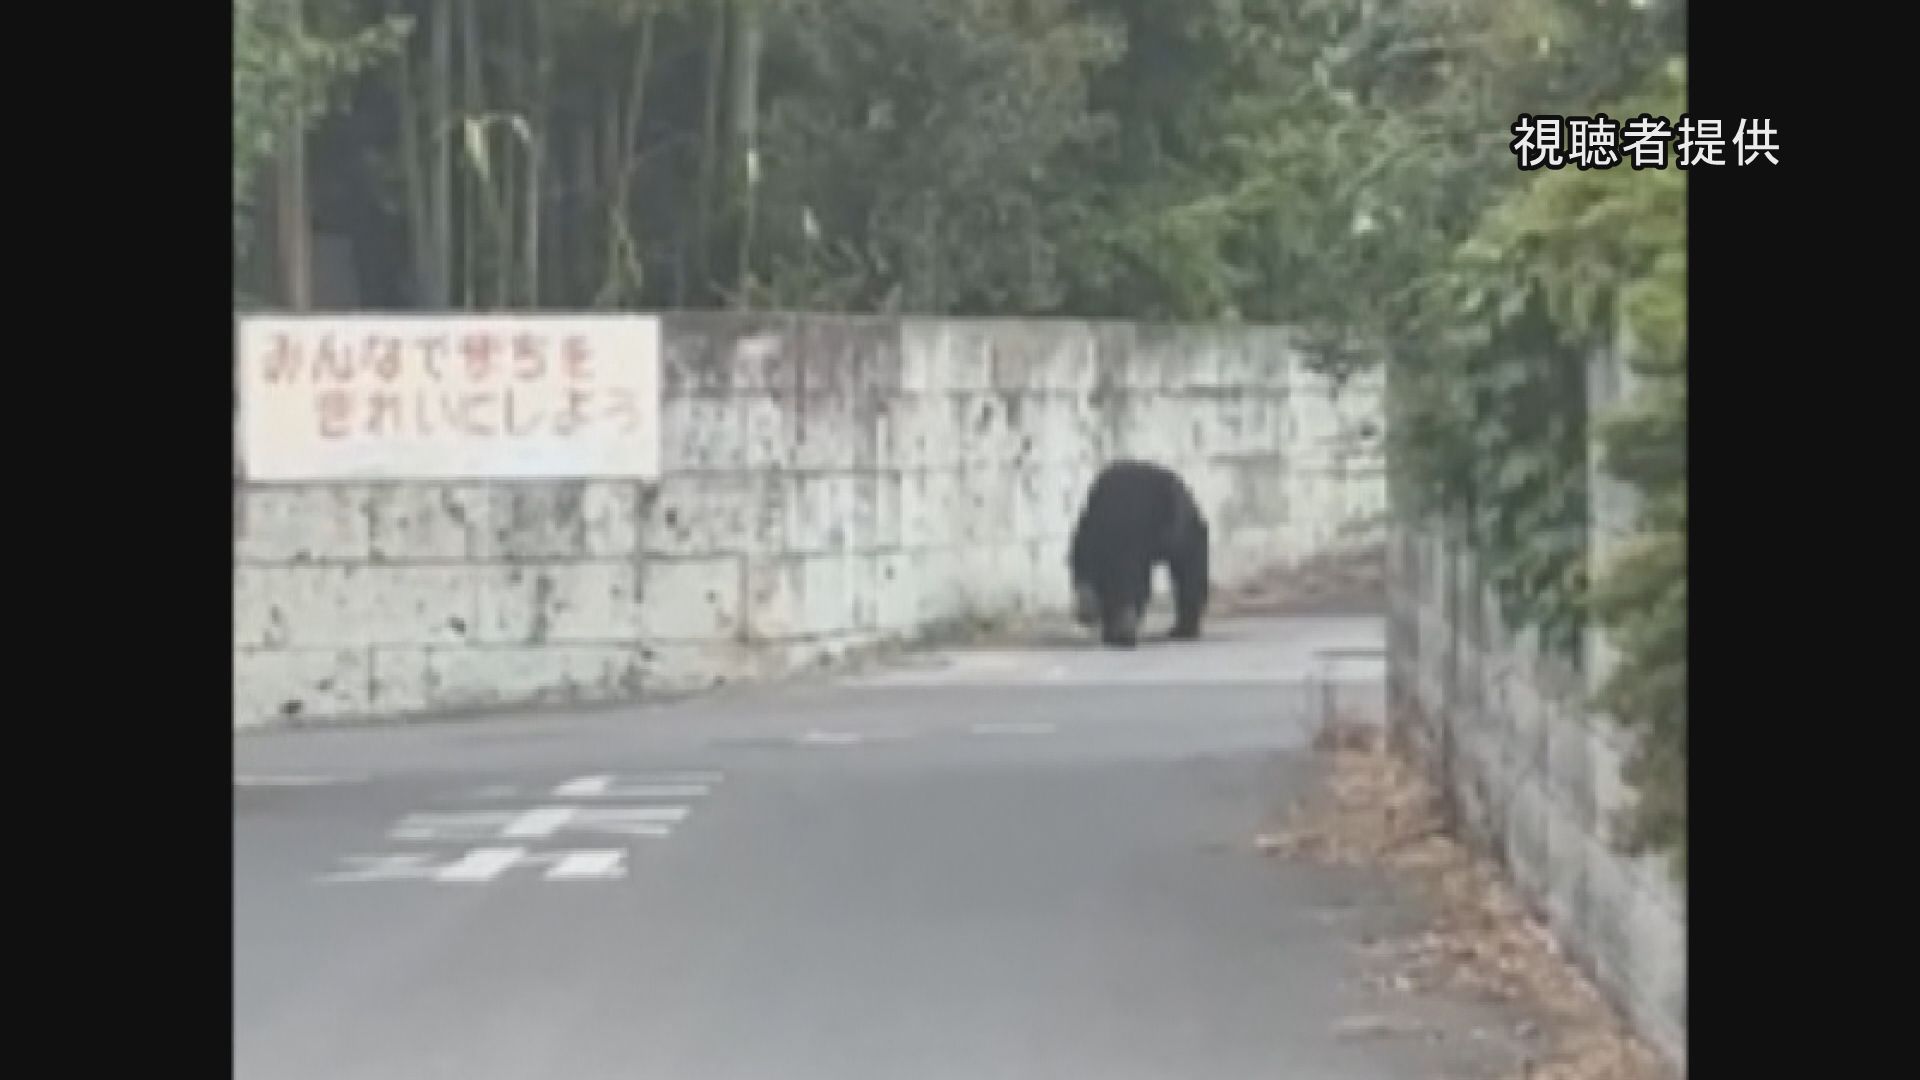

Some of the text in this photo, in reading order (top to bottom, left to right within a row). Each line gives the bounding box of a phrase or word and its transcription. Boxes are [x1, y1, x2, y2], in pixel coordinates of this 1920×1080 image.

[315, 387, 642, 439] きれいにしよう
